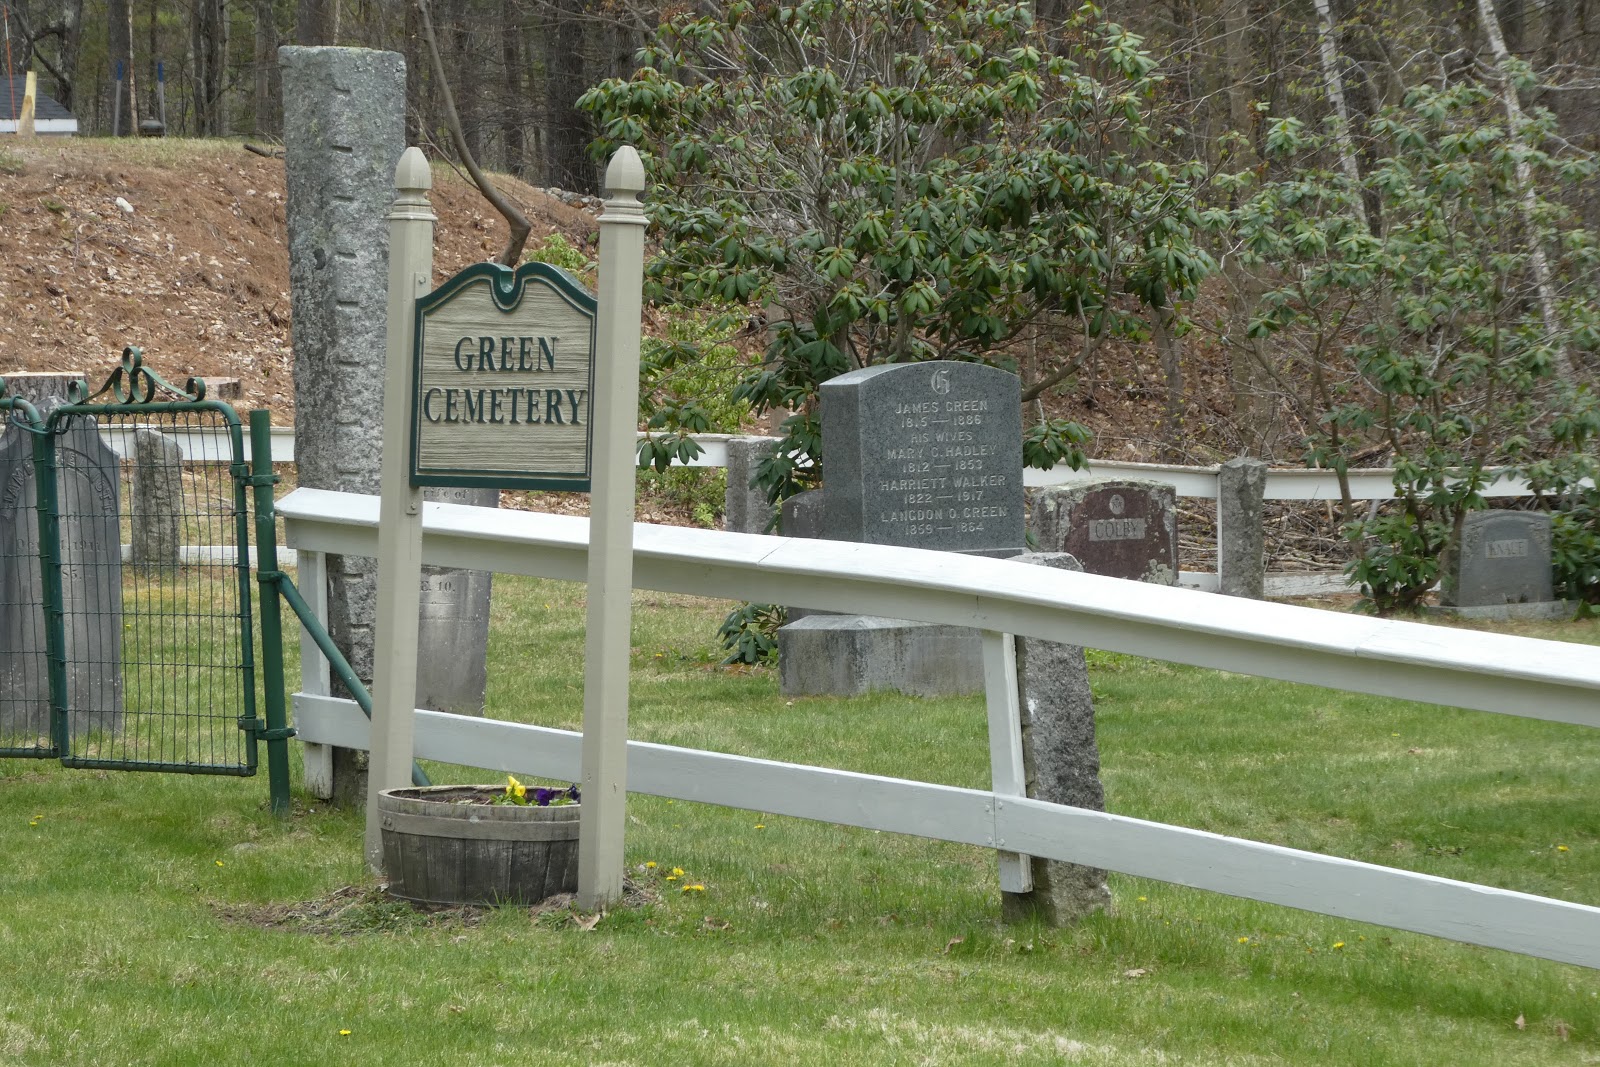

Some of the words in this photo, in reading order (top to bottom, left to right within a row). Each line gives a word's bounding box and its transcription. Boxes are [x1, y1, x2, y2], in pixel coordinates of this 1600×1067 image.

[454, 336, 559, 371] GREEN
[423, 388, 587, 424] CEMETERY
[895, 401, 939, 414] JAMES
[945, 400, 988, 412] GREEN
[953, 414, 982, 426] 1886
[911, 433, 929, 443] HIS
[935, 431, 973, 442] WIVES
[887, 447, 924, 460] MARY
[945, 445, 997, 457] HADLEY
[902, 462, 930, 473] 1812
[955, 460, 983, 471] 1853
[880, 477, 949, 491] HARRIETT
[953, 475, 1006, 488] WALKER
[904, 494, 932, 504] 1822
[957, 491, 983, 502] 1917
[881, 509, 943, 523] LANGDON
[963, 506, 1008, 518] GREEN
[1095, 521, 1139, 539] COLBY
